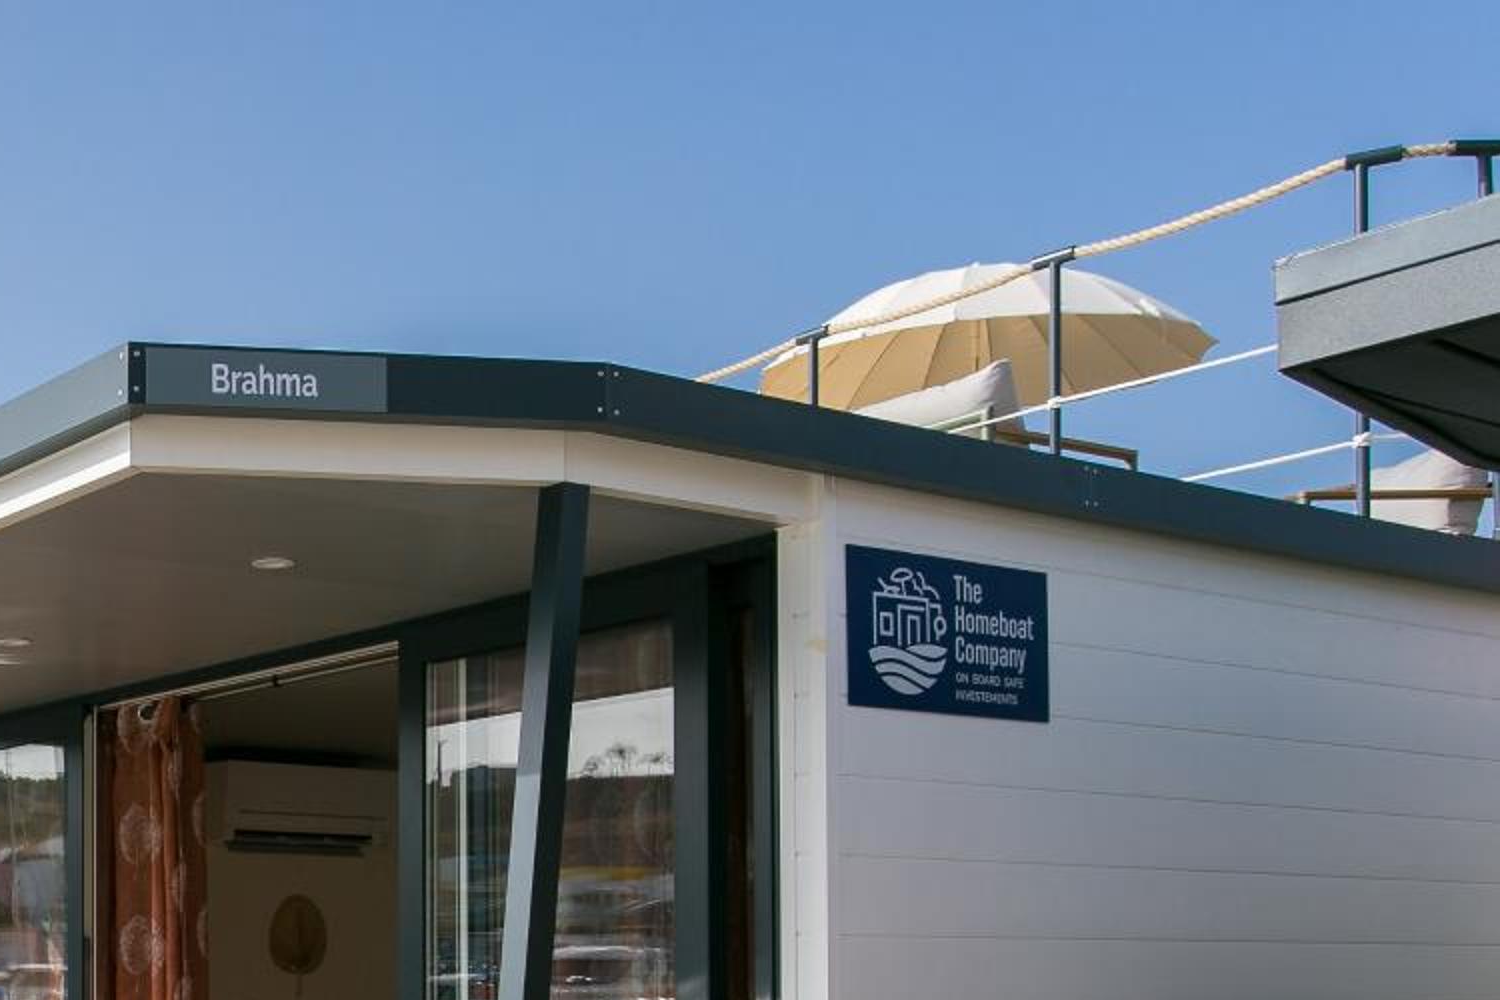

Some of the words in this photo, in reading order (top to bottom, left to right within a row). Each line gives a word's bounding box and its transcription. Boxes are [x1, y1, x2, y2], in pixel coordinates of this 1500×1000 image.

[211, 363, 319, 398] Brahma
[953, 574, 983, 604] The
[954, 604, 1035, 641] Homeboat
[954, 636, 1028, 674] Company
[955, 672, 969, 685] ON
[971, 673, 1001, 687] BOARD
